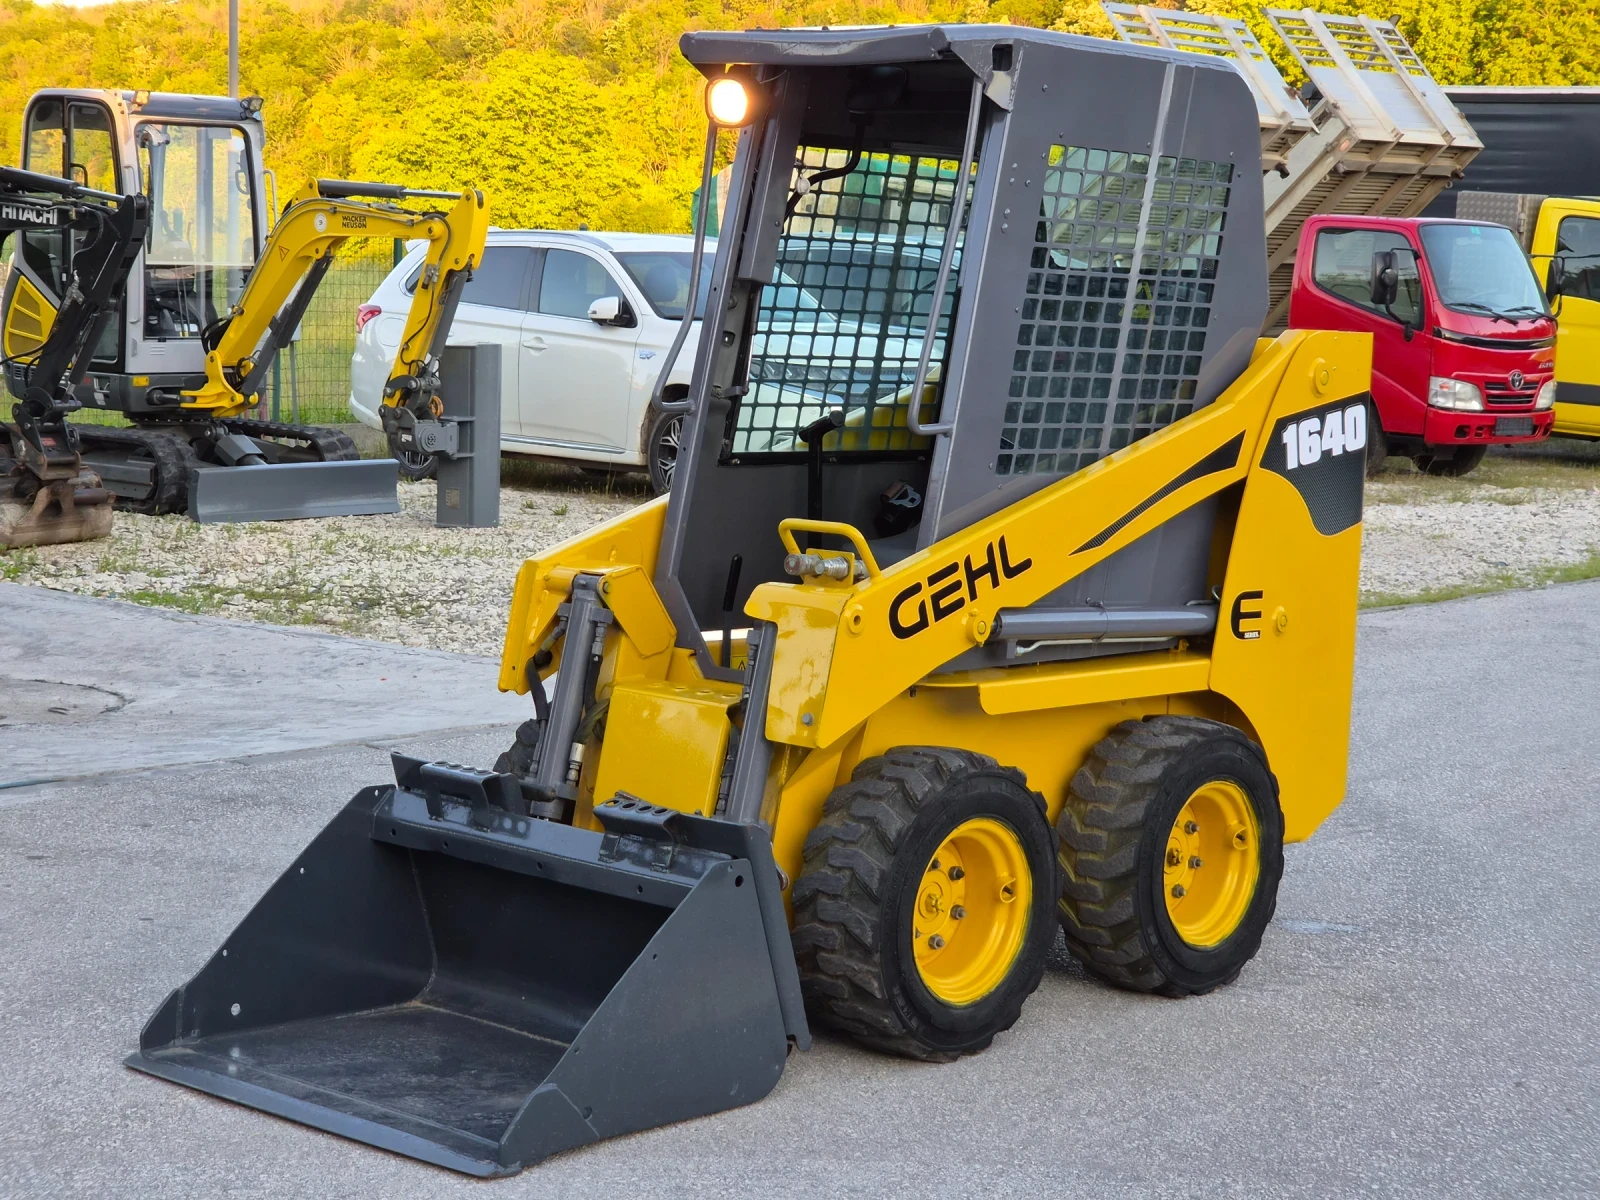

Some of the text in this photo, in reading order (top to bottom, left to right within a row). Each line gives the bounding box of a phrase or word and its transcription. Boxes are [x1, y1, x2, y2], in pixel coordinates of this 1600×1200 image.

[1282, 404, 1366, 470] 1640
[889, 534, 1033, 640] GEHL
[1230, 589, 1263, 640] E
